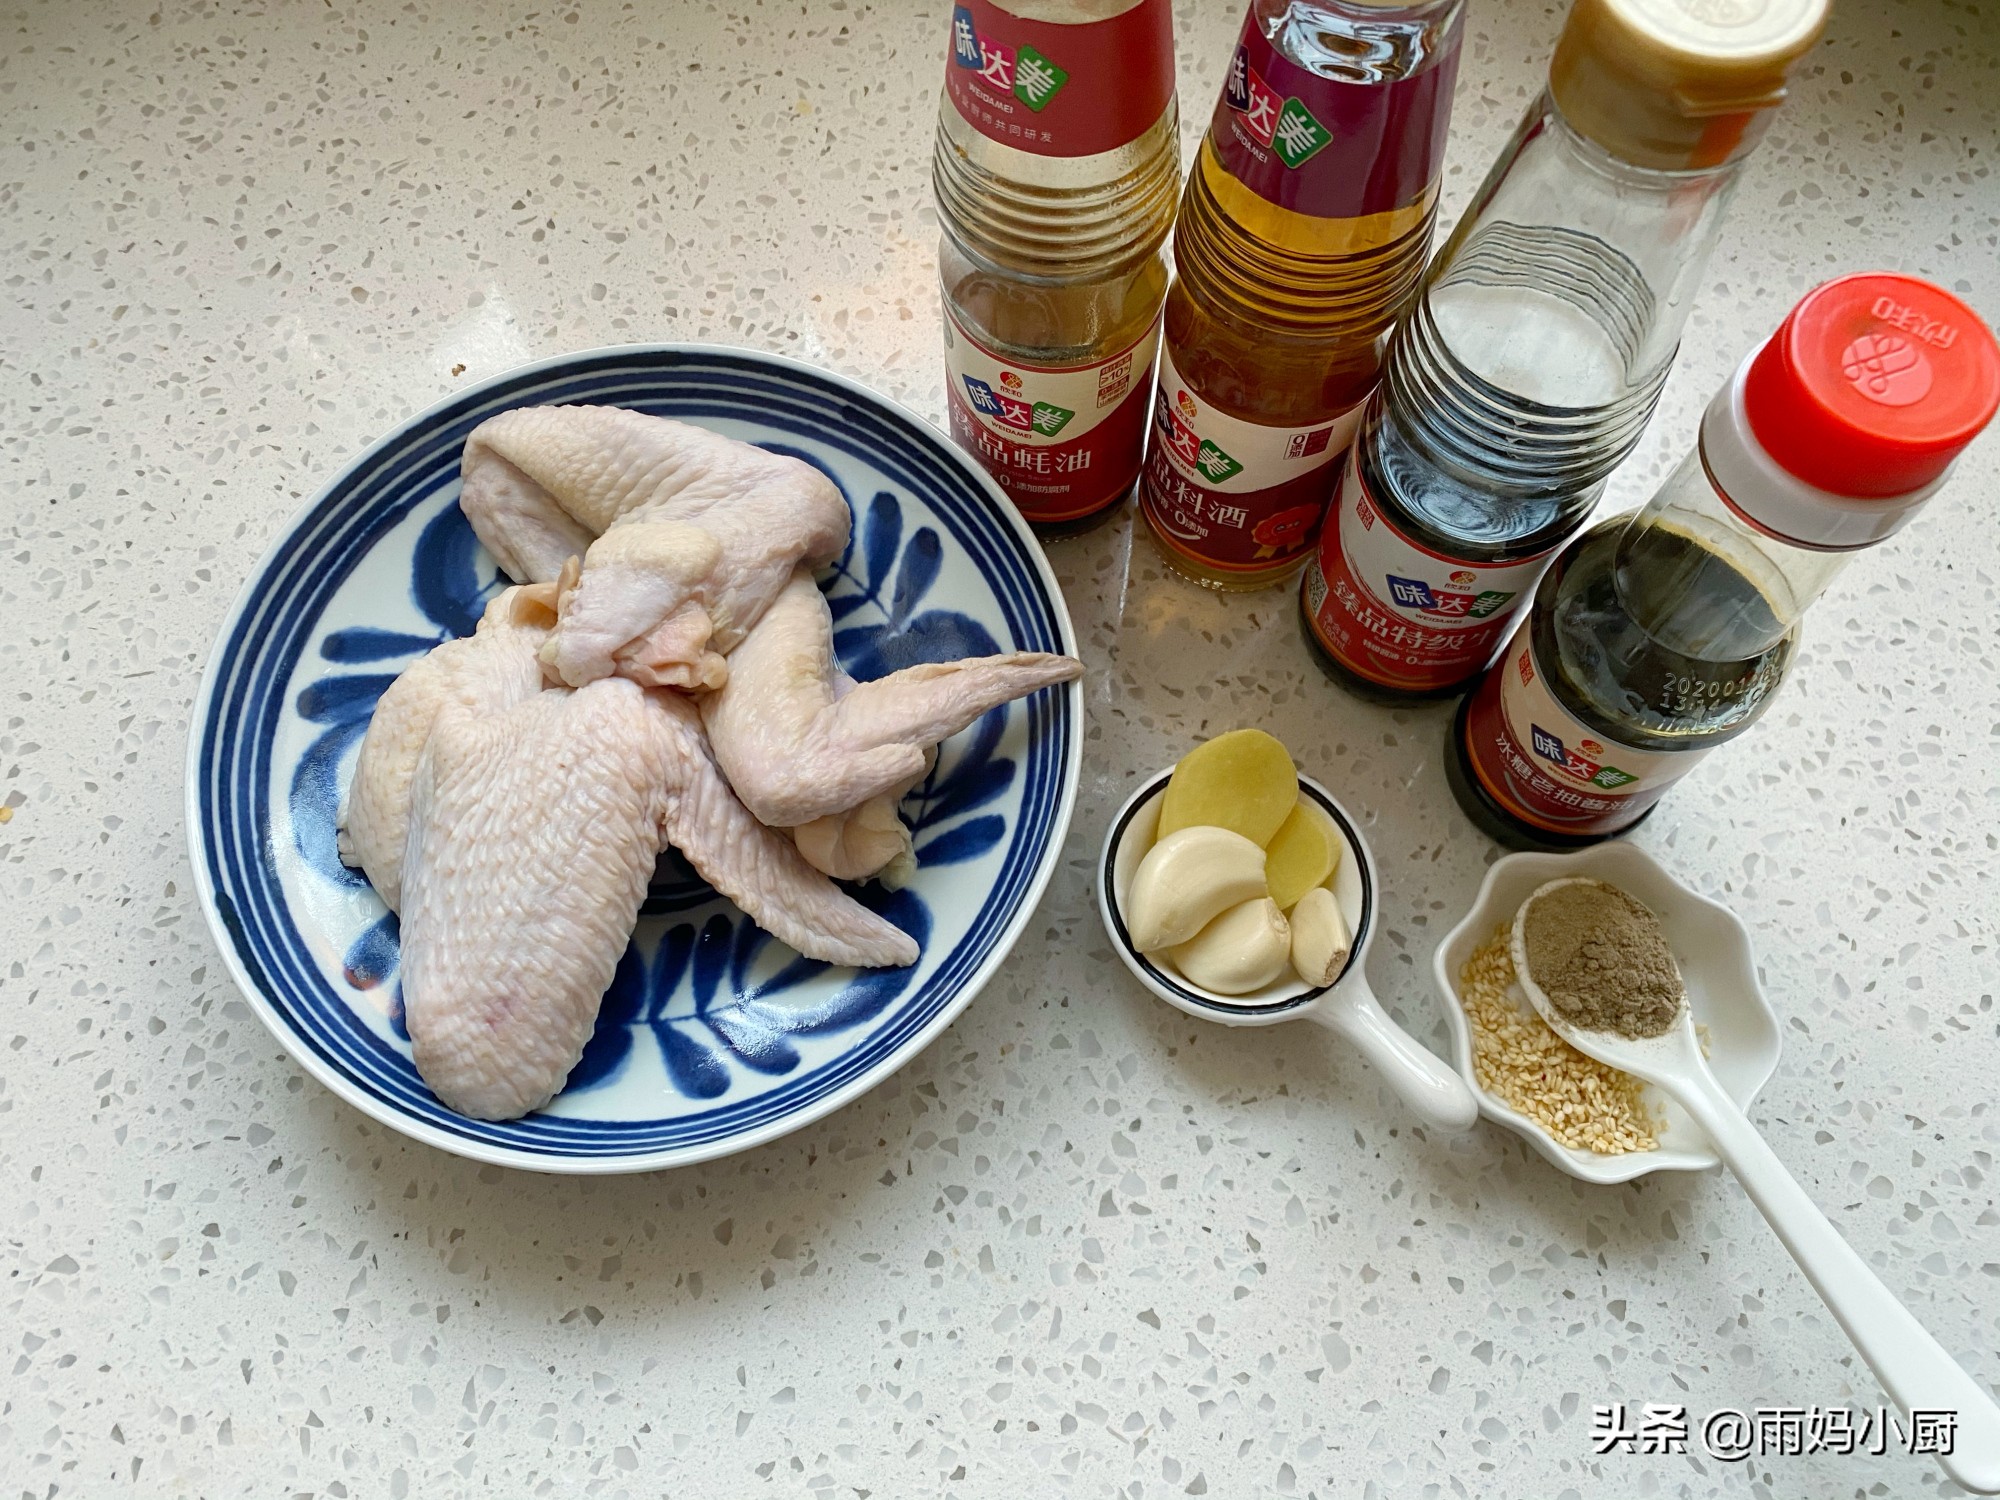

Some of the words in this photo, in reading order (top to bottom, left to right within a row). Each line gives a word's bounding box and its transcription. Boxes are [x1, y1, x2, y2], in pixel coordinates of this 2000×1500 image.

[955, 19, 1056, 103] 味达美
[968, 82, 1014, 114] WEIDAMEI
[1228, 56, 1317, 158] 味达美
[1231, 121, 1268, 163] WEIDAMEI
[968, 383, 1062, 431] 味达美
[991, 421, 1032, 439] WEIDAMEI
[1395, 581, 1504, 616] 味达美
[1415, 613, 1463, 625] WEIDAMEI
[1534, 731, 1628, 786] 味达美
